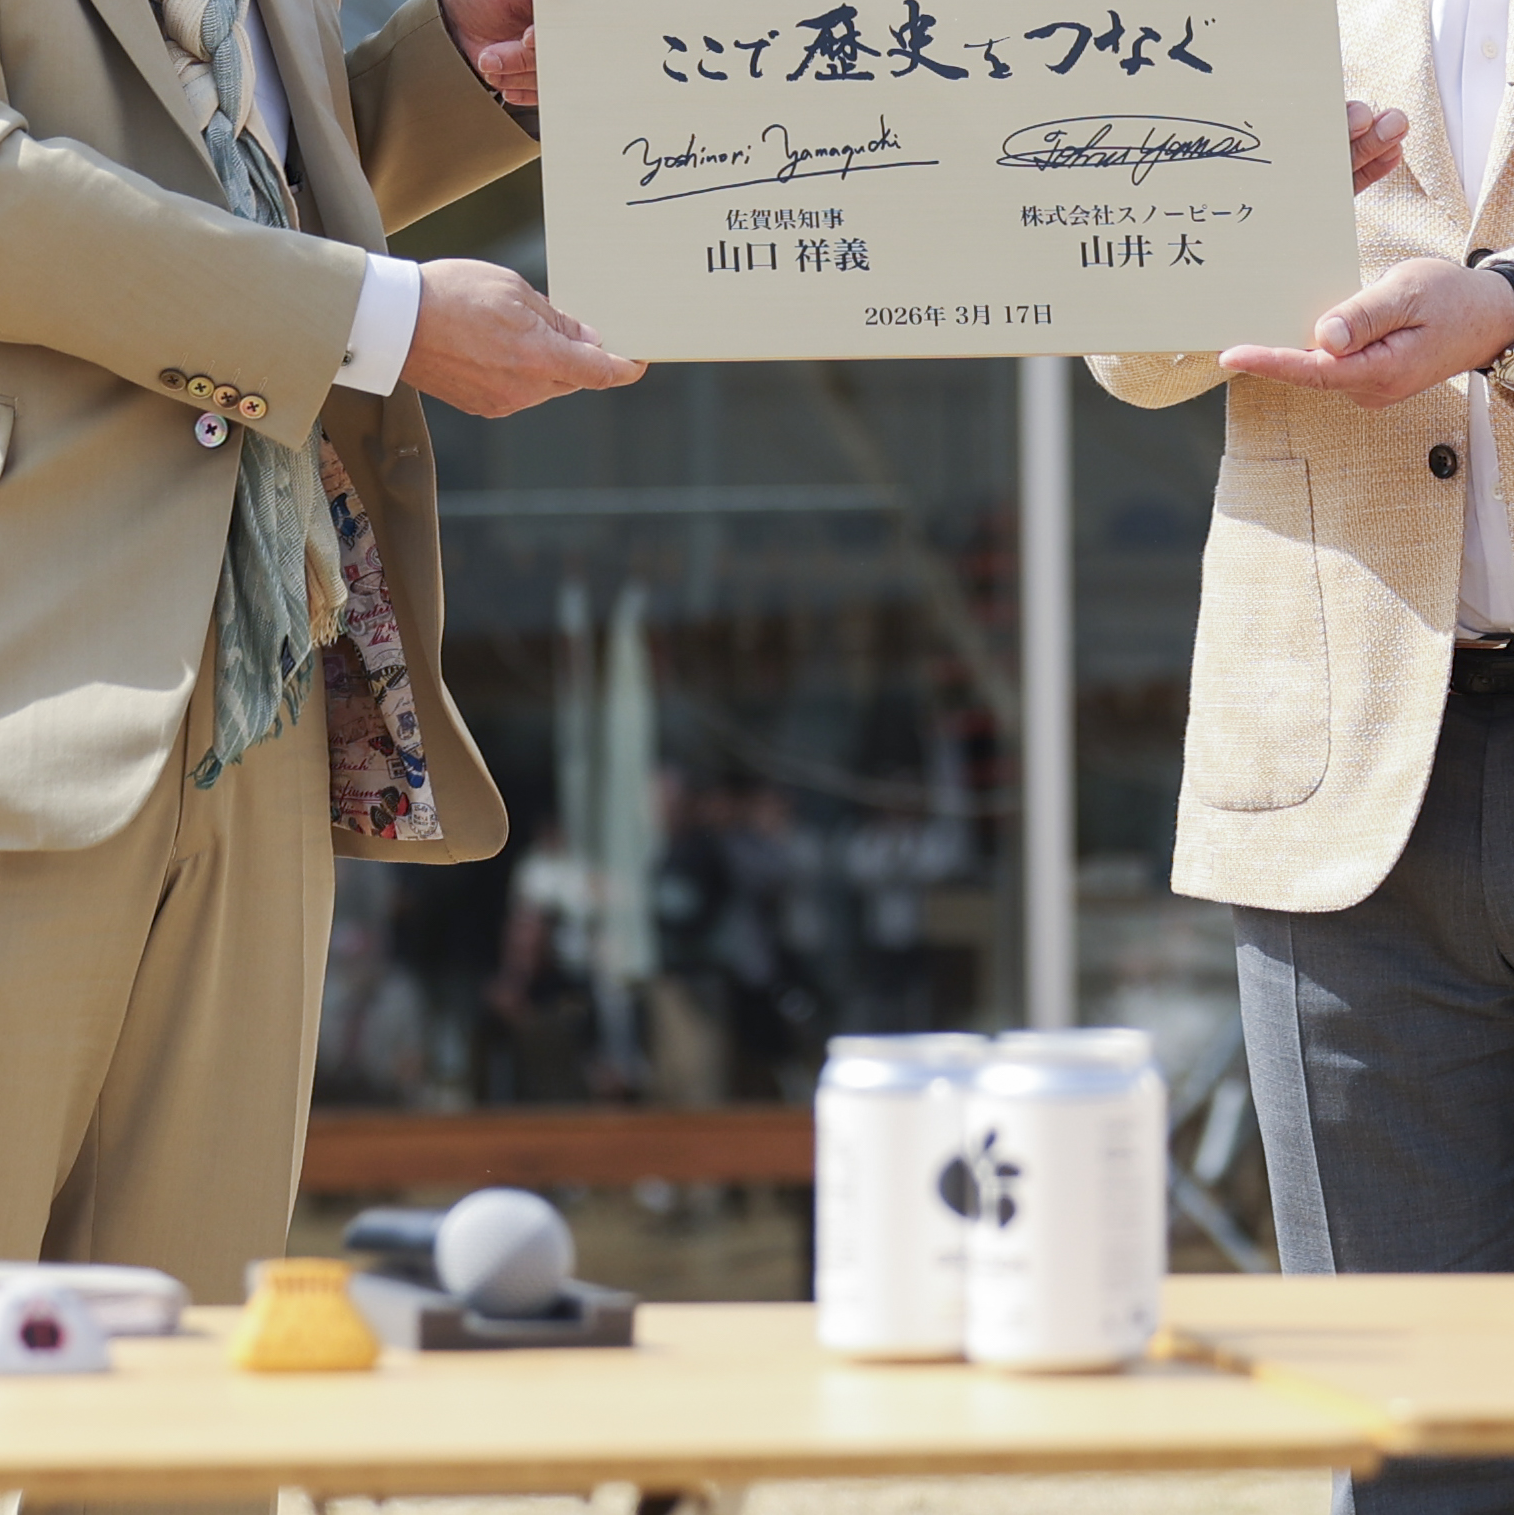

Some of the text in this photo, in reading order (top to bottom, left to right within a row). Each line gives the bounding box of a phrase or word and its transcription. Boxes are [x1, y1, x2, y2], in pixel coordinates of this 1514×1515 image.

[725, 207, 845, 230] 佐賀県知事
[1020, 203, 1253, 228] 株式会社スノーピーク
[706, 237, 871, 274] 山口 祥義
[1080, 233, 1206, 269] 山井 太
[864, 303, 1052, 328] 2026年 3月 17日
